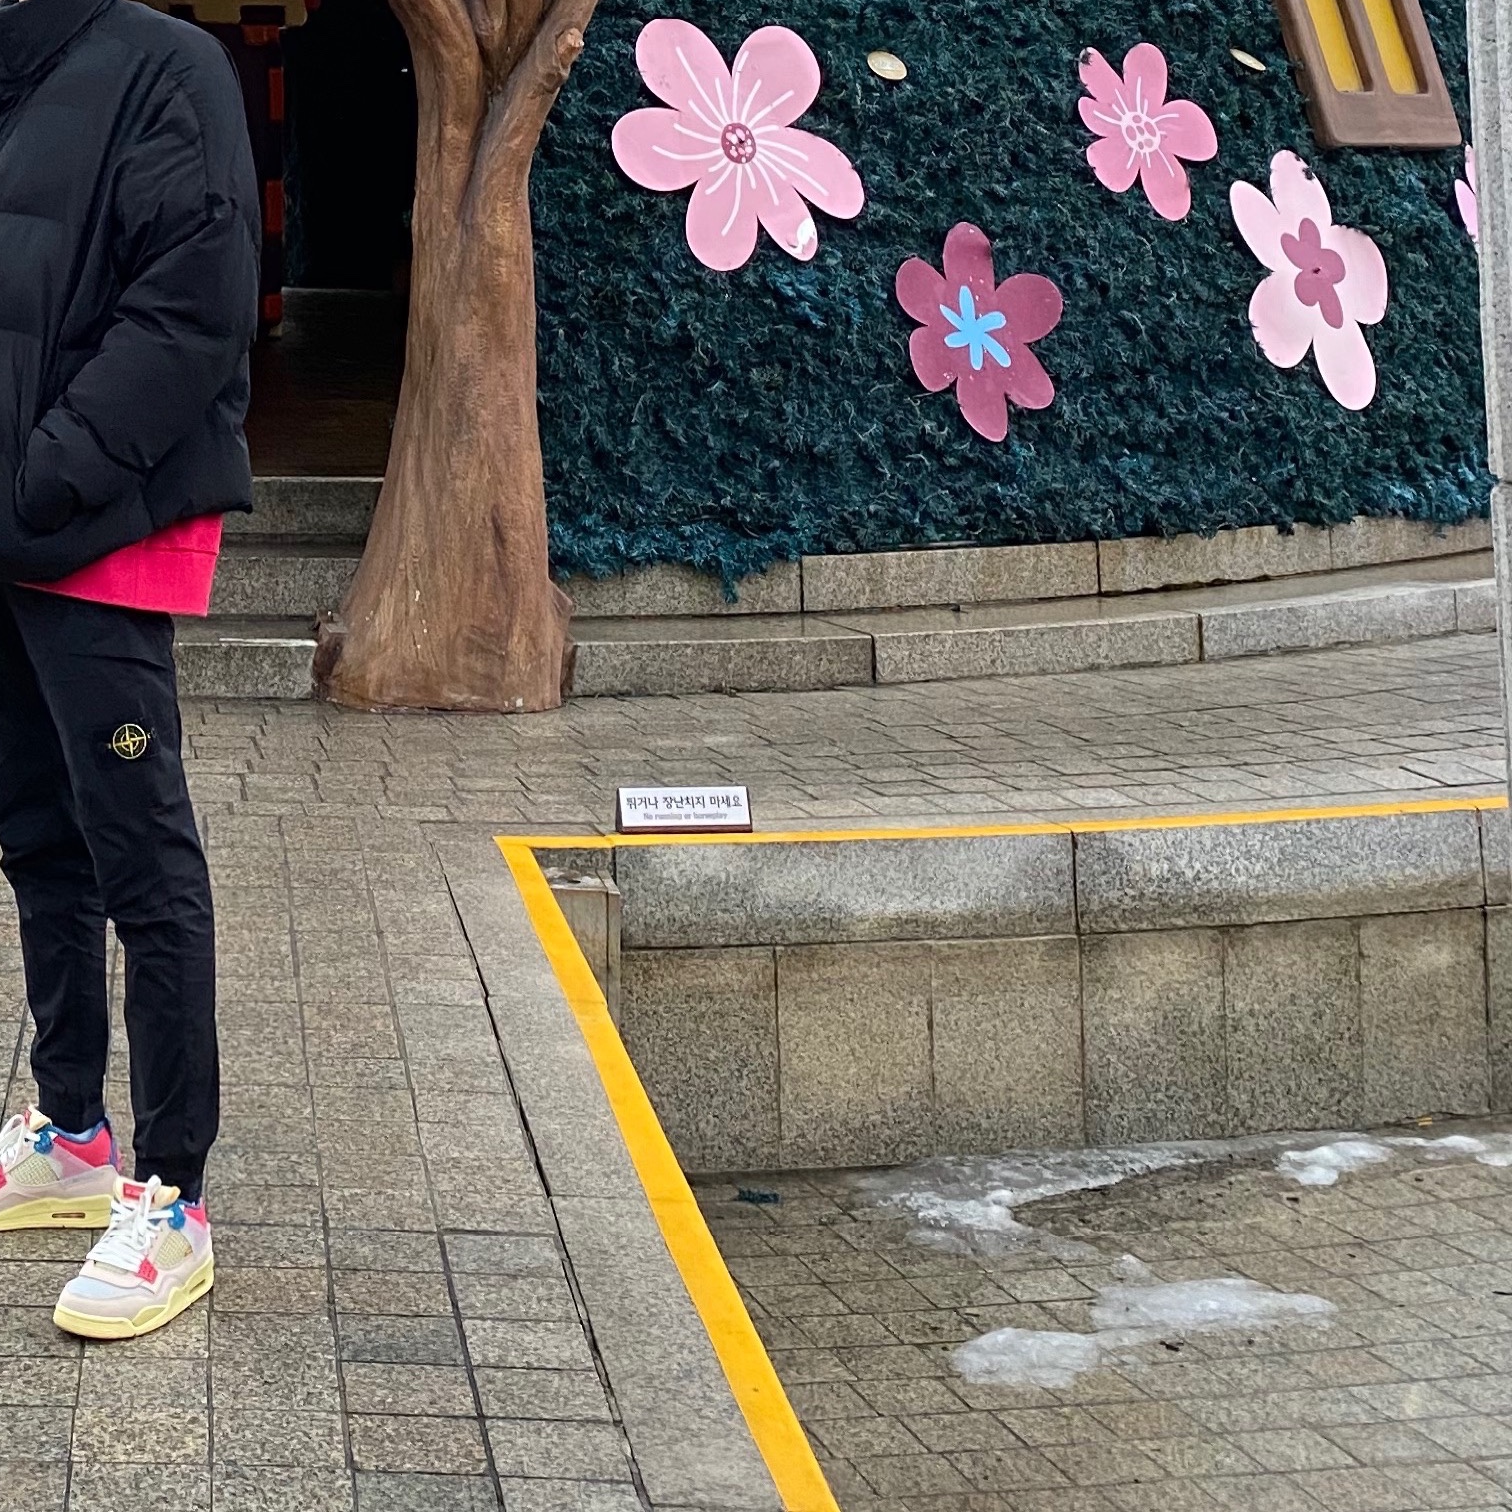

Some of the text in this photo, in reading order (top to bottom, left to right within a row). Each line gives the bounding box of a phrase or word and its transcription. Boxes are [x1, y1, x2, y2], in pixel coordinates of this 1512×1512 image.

[626, 795, 743, 810] 뛰거나 장난치지 마세요
